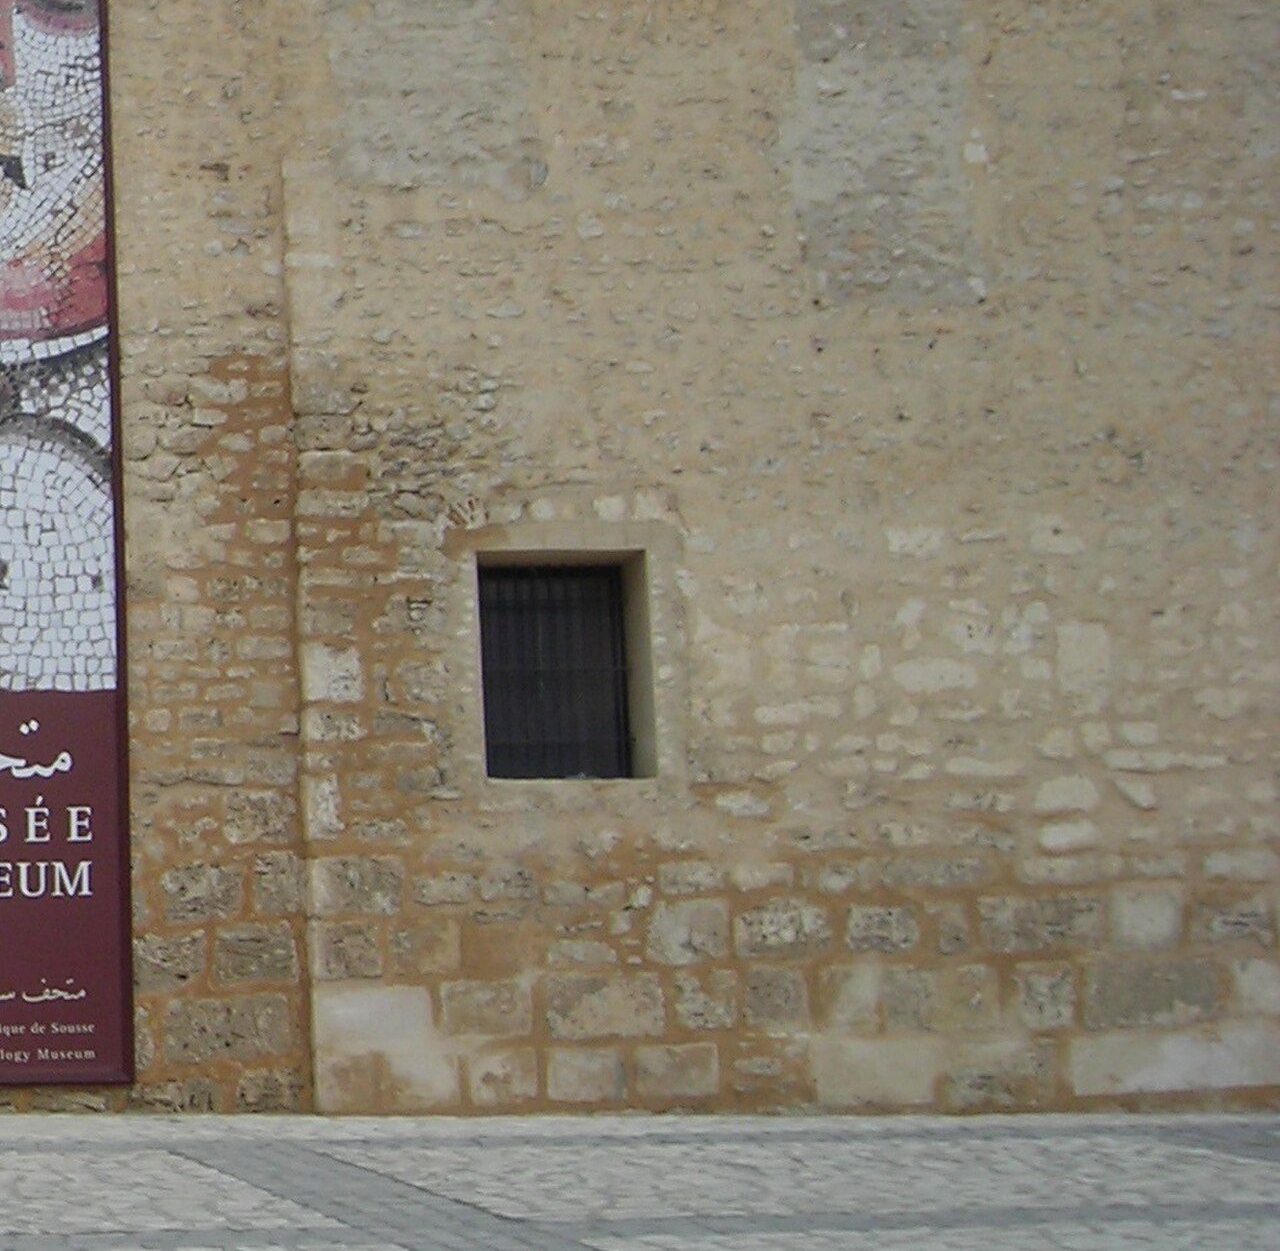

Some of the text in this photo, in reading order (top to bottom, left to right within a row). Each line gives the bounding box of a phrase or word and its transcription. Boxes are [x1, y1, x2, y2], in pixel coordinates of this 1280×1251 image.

[22, 978, 87, 1003] متحف
[30, 1021, 46, 1035] de
[50, 1021, 95, 1035] Sousse
[37, 1048, 96, 1060] Museum
